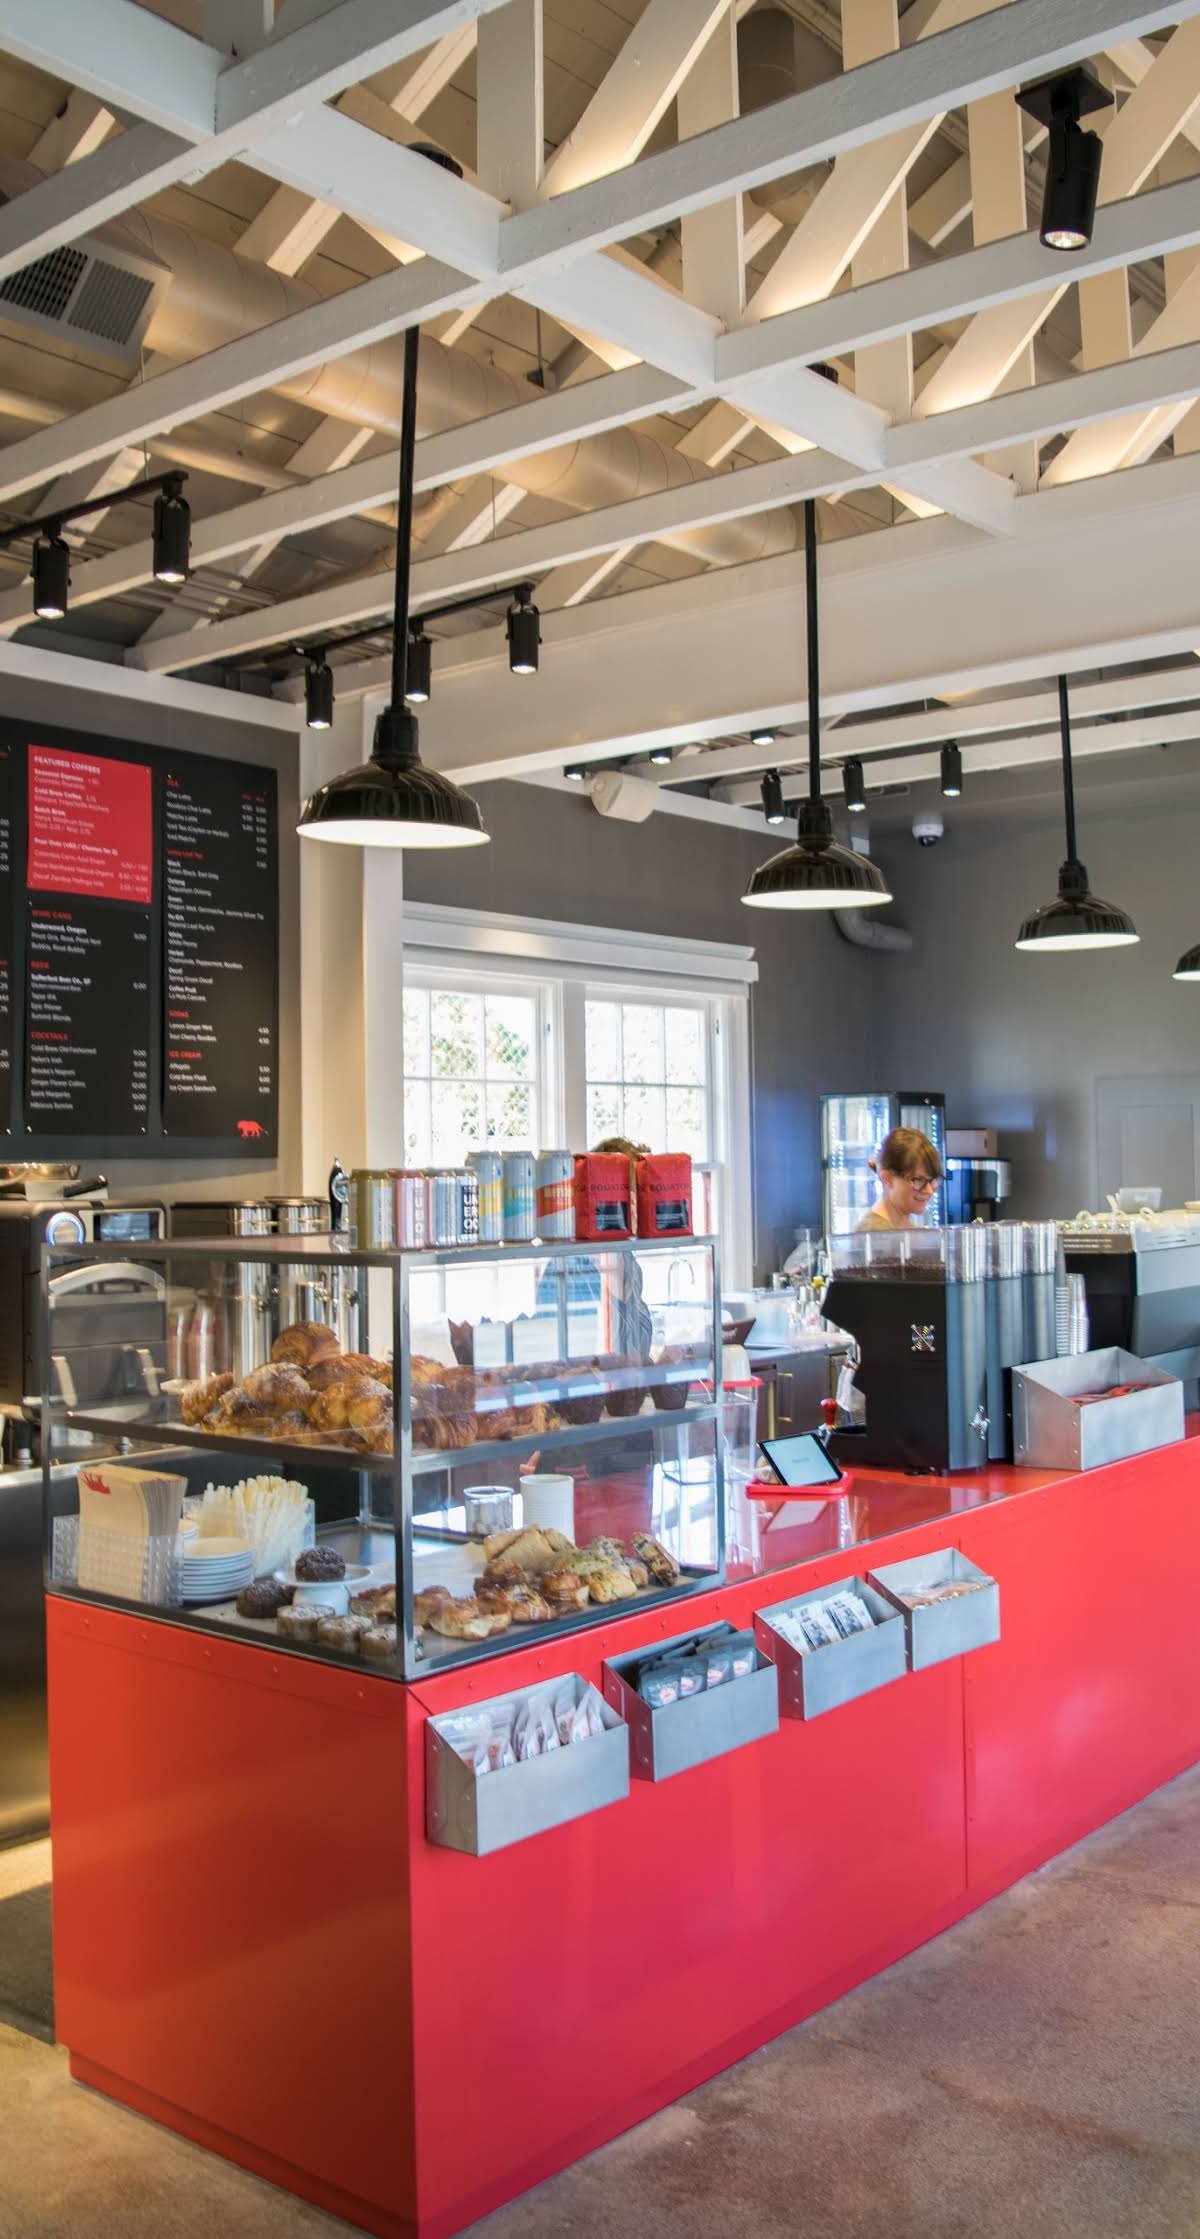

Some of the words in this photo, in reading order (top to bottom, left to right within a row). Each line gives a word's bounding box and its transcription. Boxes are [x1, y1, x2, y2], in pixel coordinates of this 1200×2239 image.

[34, 756, 70, 768] FEATURED
[71, 762, 100, 774] COFFEES
[34, 786, 48, 794] Cold
[49, 790, 63, 798] Brew
[64, 792, 82, 800] Coffee
[166, 791, 178, 800] Chai
[34, 805, 50, 814] Batch
[52, 808, 66, 816] Brew
[199, 806, 212, 816] Latte
[185, 815, 198, 823] Latte
[48, 840, 62, 848] Over
[167, 877, 186, 887] Oolong
[32, 910, 51, 918] WINE
[52, 911, 72, 920] CANS
[66, 926, 88, 935] Oregon
[168, 931, 183, 940] White
[31, 960, 50, 969] BEER
[58, 976, 72, 984] Beer
[168, 984, 185, 994] Coffee
[169, 1010, 189, 1019] SODAS
[169, 1022, 185, 1030] Lemon
[31, 1031, 68, 1040] COCKTAILS
[31, 1044, 44, 1052] Cold
[170, 1050, 180, 1059] ICE
[180, 1050, 202, 1060] CREAM
[169, 1062, 191, 1072] Affogato
[169, 1074, 182, 1082] Cold
[177, 1084, 194, 1094] Cream
[194, 1084, 217, 1094] Sandwich
